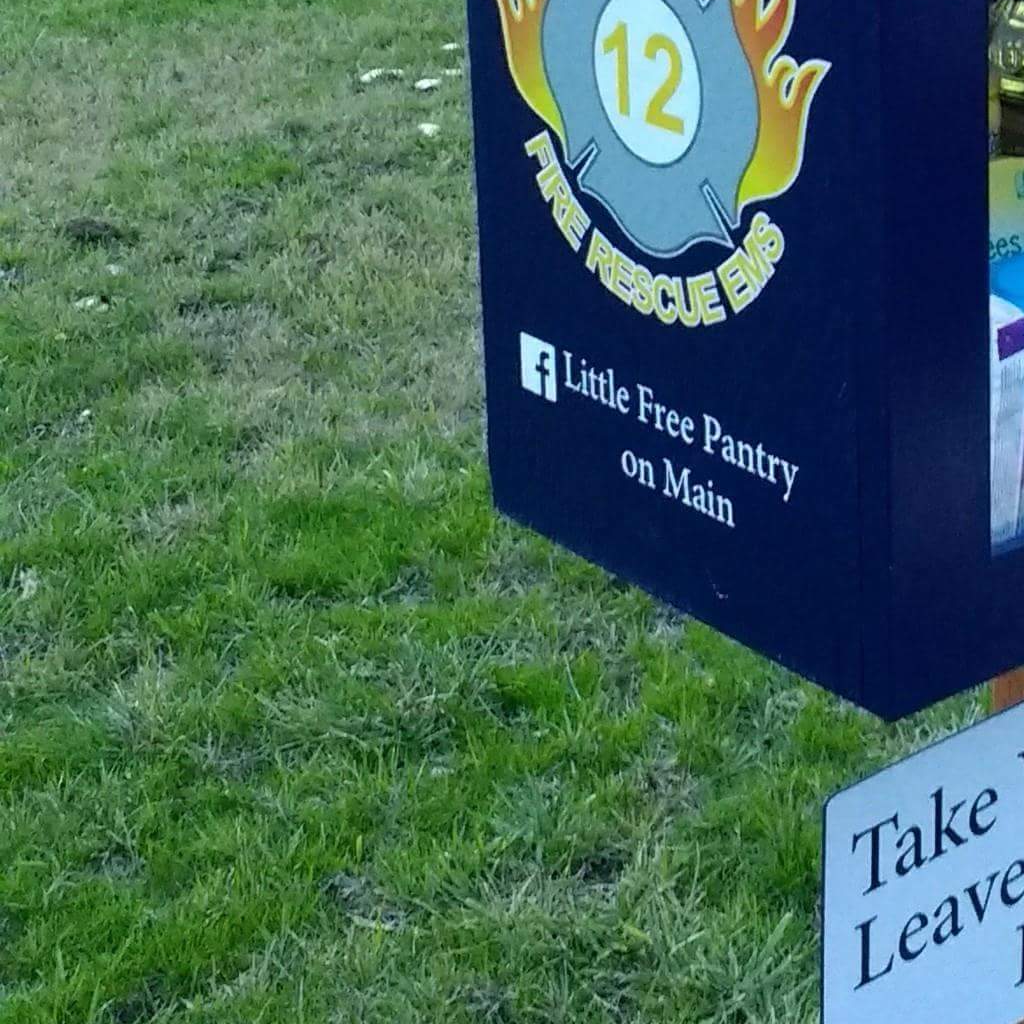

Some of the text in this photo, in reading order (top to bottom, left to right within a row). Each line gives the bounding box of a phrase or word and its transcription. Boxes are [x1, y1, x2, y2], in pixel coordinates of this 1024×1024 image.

[602, 20, 685, 136] 12
[524, 129, 785, 327] FIRE RESCUE EMS
[563, 350, 630, 413] Little
[637, 384, 695, 445] Free
[702, 414, 799, 502] Pantry
[620, 450, 736, 528] on Main
[851, 786, 998, 897] Take
